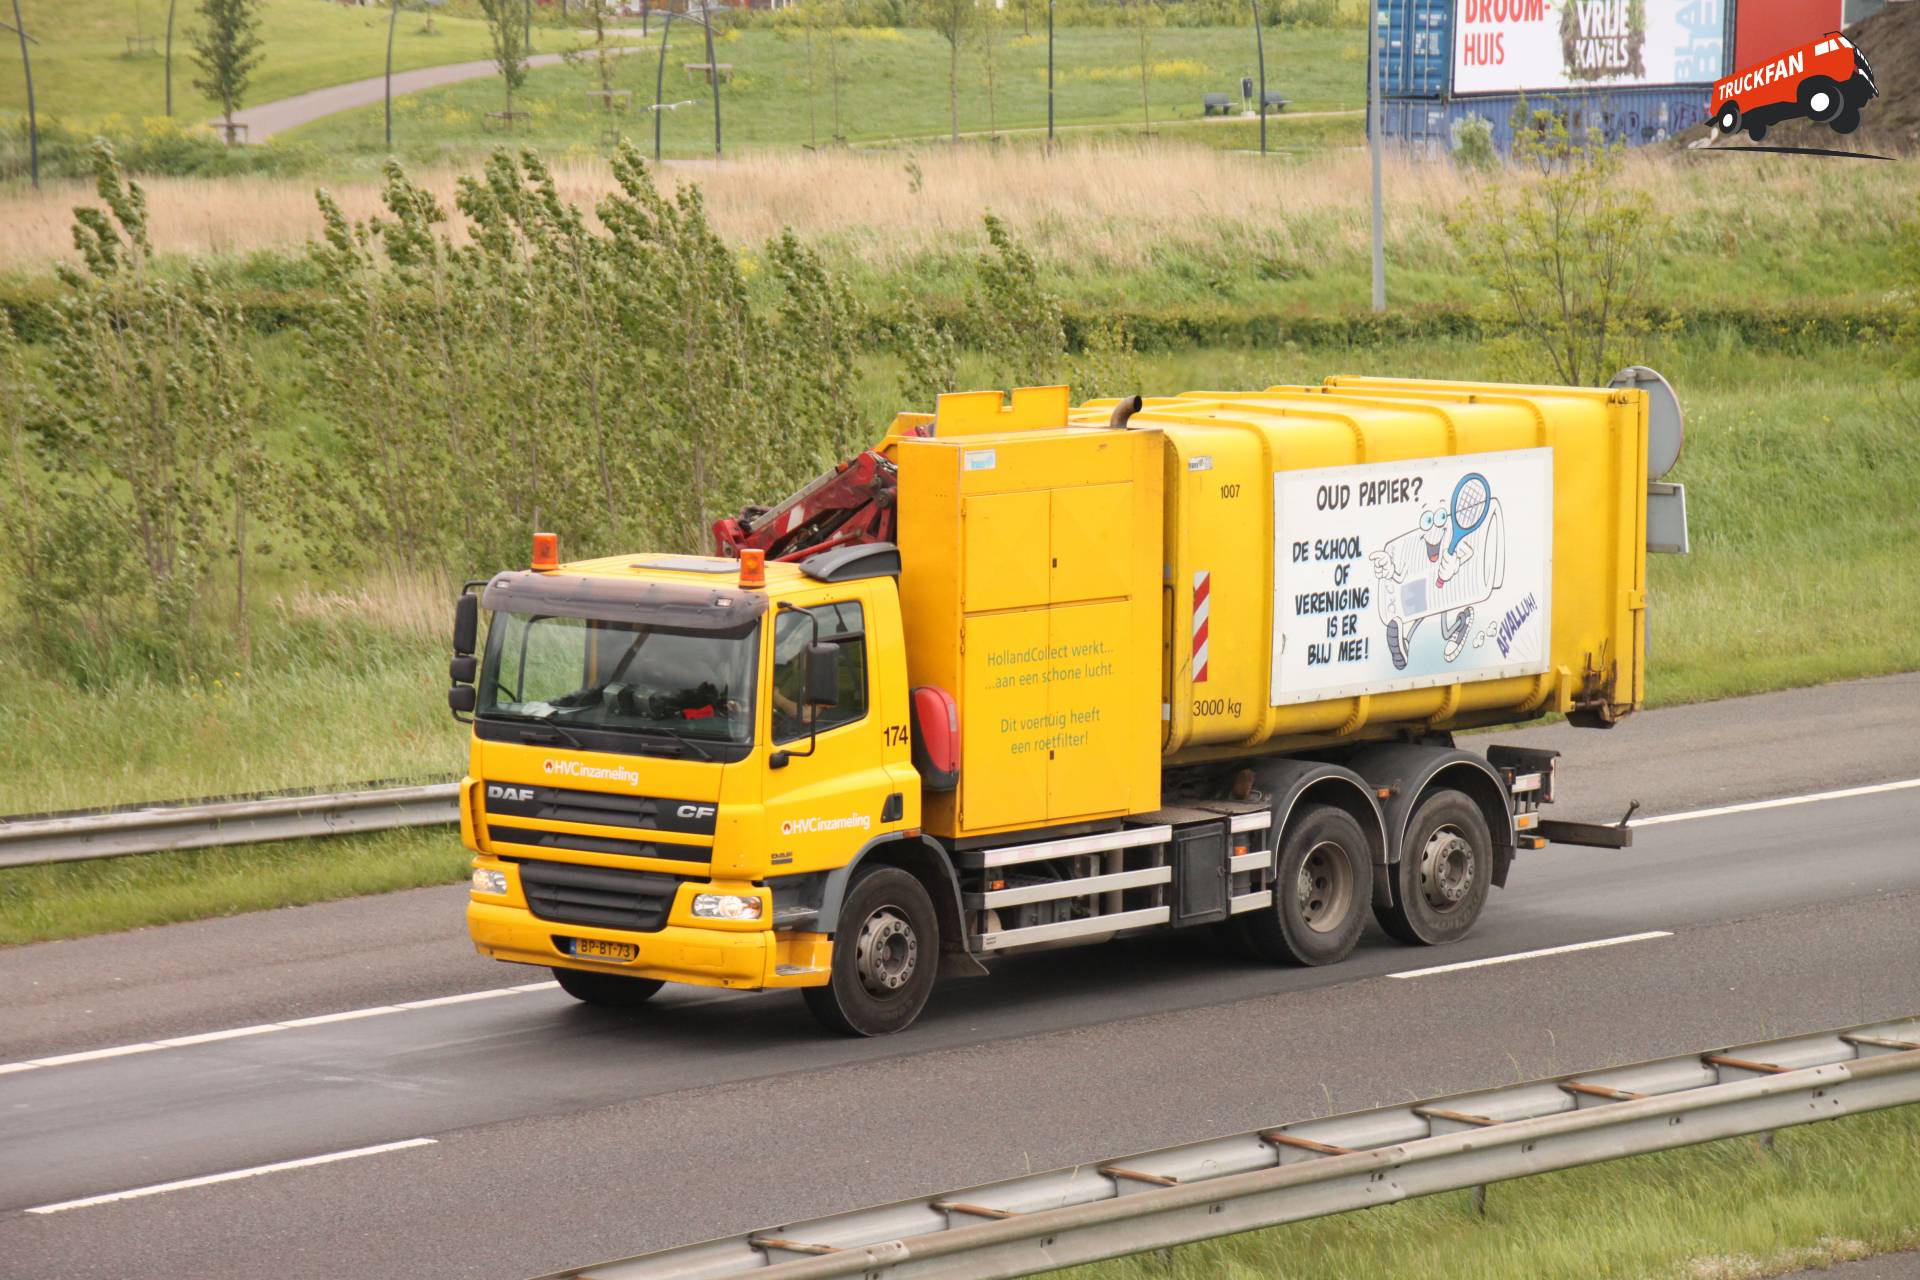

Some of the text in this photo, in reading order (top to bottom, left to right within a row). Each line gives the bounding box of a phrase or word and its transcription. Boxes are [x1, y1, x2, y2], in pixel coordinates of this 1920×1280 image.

[1465, 0, 1550, 23] DROOM-
[1577, 0, 1630, 37] VRIJE
[1464, 32, 1504, 66] HUIS
[1575, 38, 1629, 68] KAVELS
[1220, 484, 1240, 499] 1007
[1317, 477, 1423, 511] OUD PAPIER?
[1293, 536, 1362, 563] DE SCHOOL
[1334, 564, 1350, 586] OF
[1295, 587, 1370, 615] VERENIGING
[1327, 614, 1358, 638] IS ER
[1496, 592, 1538, 659] AFVALLUH!
[987, 640, 1114, 667] HollandCollect werkt...
[1308, 637, 1369, 665] BLIJ MEE!
[985, 675, 1015, 690] ...aan
[1019, 671, 1039, 686] een
[1042, 667, 1082, 683] schone
[1193, 697, 1242, 718] 3000 kg
[1001, 707, 1101, 733] Dit voertuig heeft
[883, 724, 909, 747] 174
[1011, 731, 1088, 754] een roetfilter!
[488, 786, 534, 802] DAF
[676, 805, 715, 819] CF
[580, 939, 631, 958] BP-BT-73
